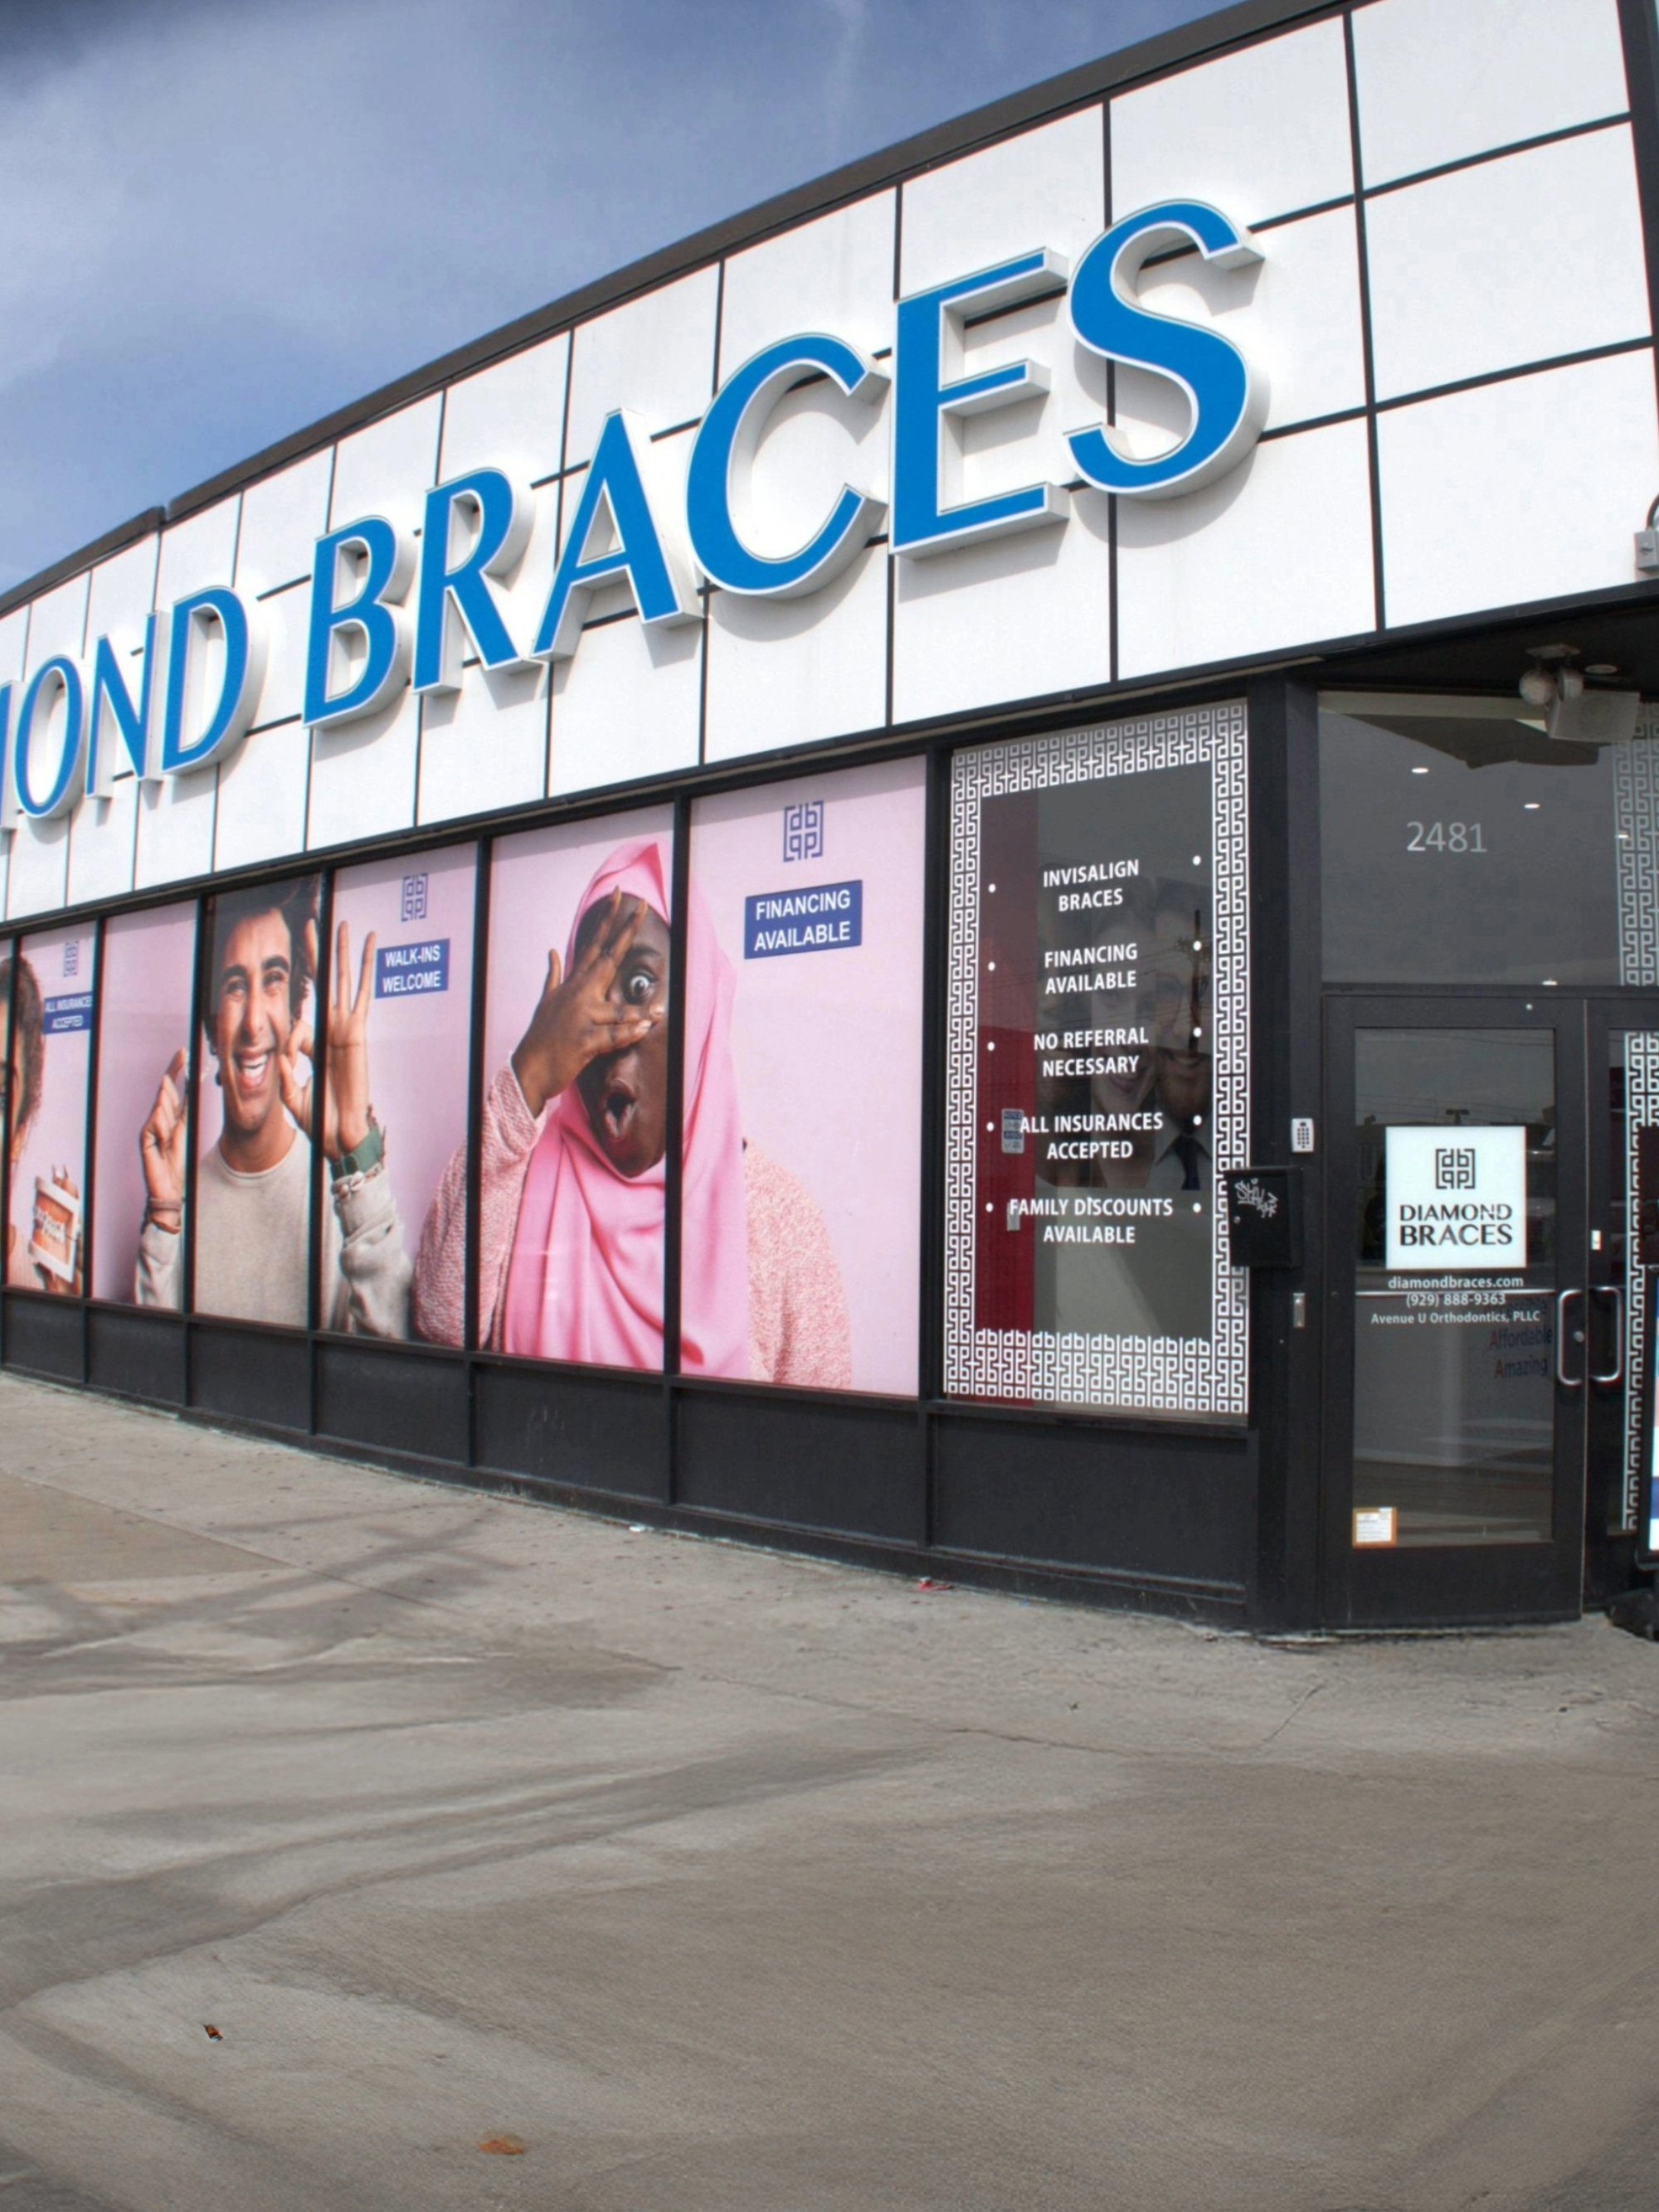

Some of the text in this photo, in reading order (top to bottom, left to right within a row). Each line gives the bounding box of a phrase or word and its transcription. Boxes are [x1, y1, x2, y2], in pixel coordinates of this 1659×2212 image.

[0, 199, 1259, 828] OND BRACES
[1405, 820, 1487, 854] 2481
[1043, 858, 1140, 888] INVISALIGN
[756, 888, 851, 921] FINANCING
[1058, 887, 1124, 912] BRACES
[754, 921, 851, 952] AVAILABLE
[385, 944, 441, 968] WALK-INS
[1044, 943, 1138, 969] FINANCING
[382, 970, 441, 994] WELCOME
[1044, 969, 1137, 995] AVAILABLE
[1033, 1027, 1150, 1051] NO REFERRAL
[1042, 1055, 1140, 1078] NECESSARY
[1019, 1114, 1051, 1133] ALL
[1053, 1111, 1164, 1133] INSURANCES
[1047, 1140, 1134, 1160] ACCEPTED
[1009, 1198, 1174, 1217] FAMILY DISCOUNTS
[1399, 1203, 1513, 1222] DIAMOND
[1043, 1228, 1136, 1245] AVAILABLE
[1399, 1223, 1513, 1247] BRACES
[1388, 1275, 1525, 1290] diamondbraces.com
[1405, 1292, 1506, 1309] (929) 888-9363
[1370, 1309, 1541, 1325] Avenue U Orthodontics, PLLC
[1487, 1326, 1553, 1350] Affordable
[1494, 1355, 1549, 1378] Amazing
